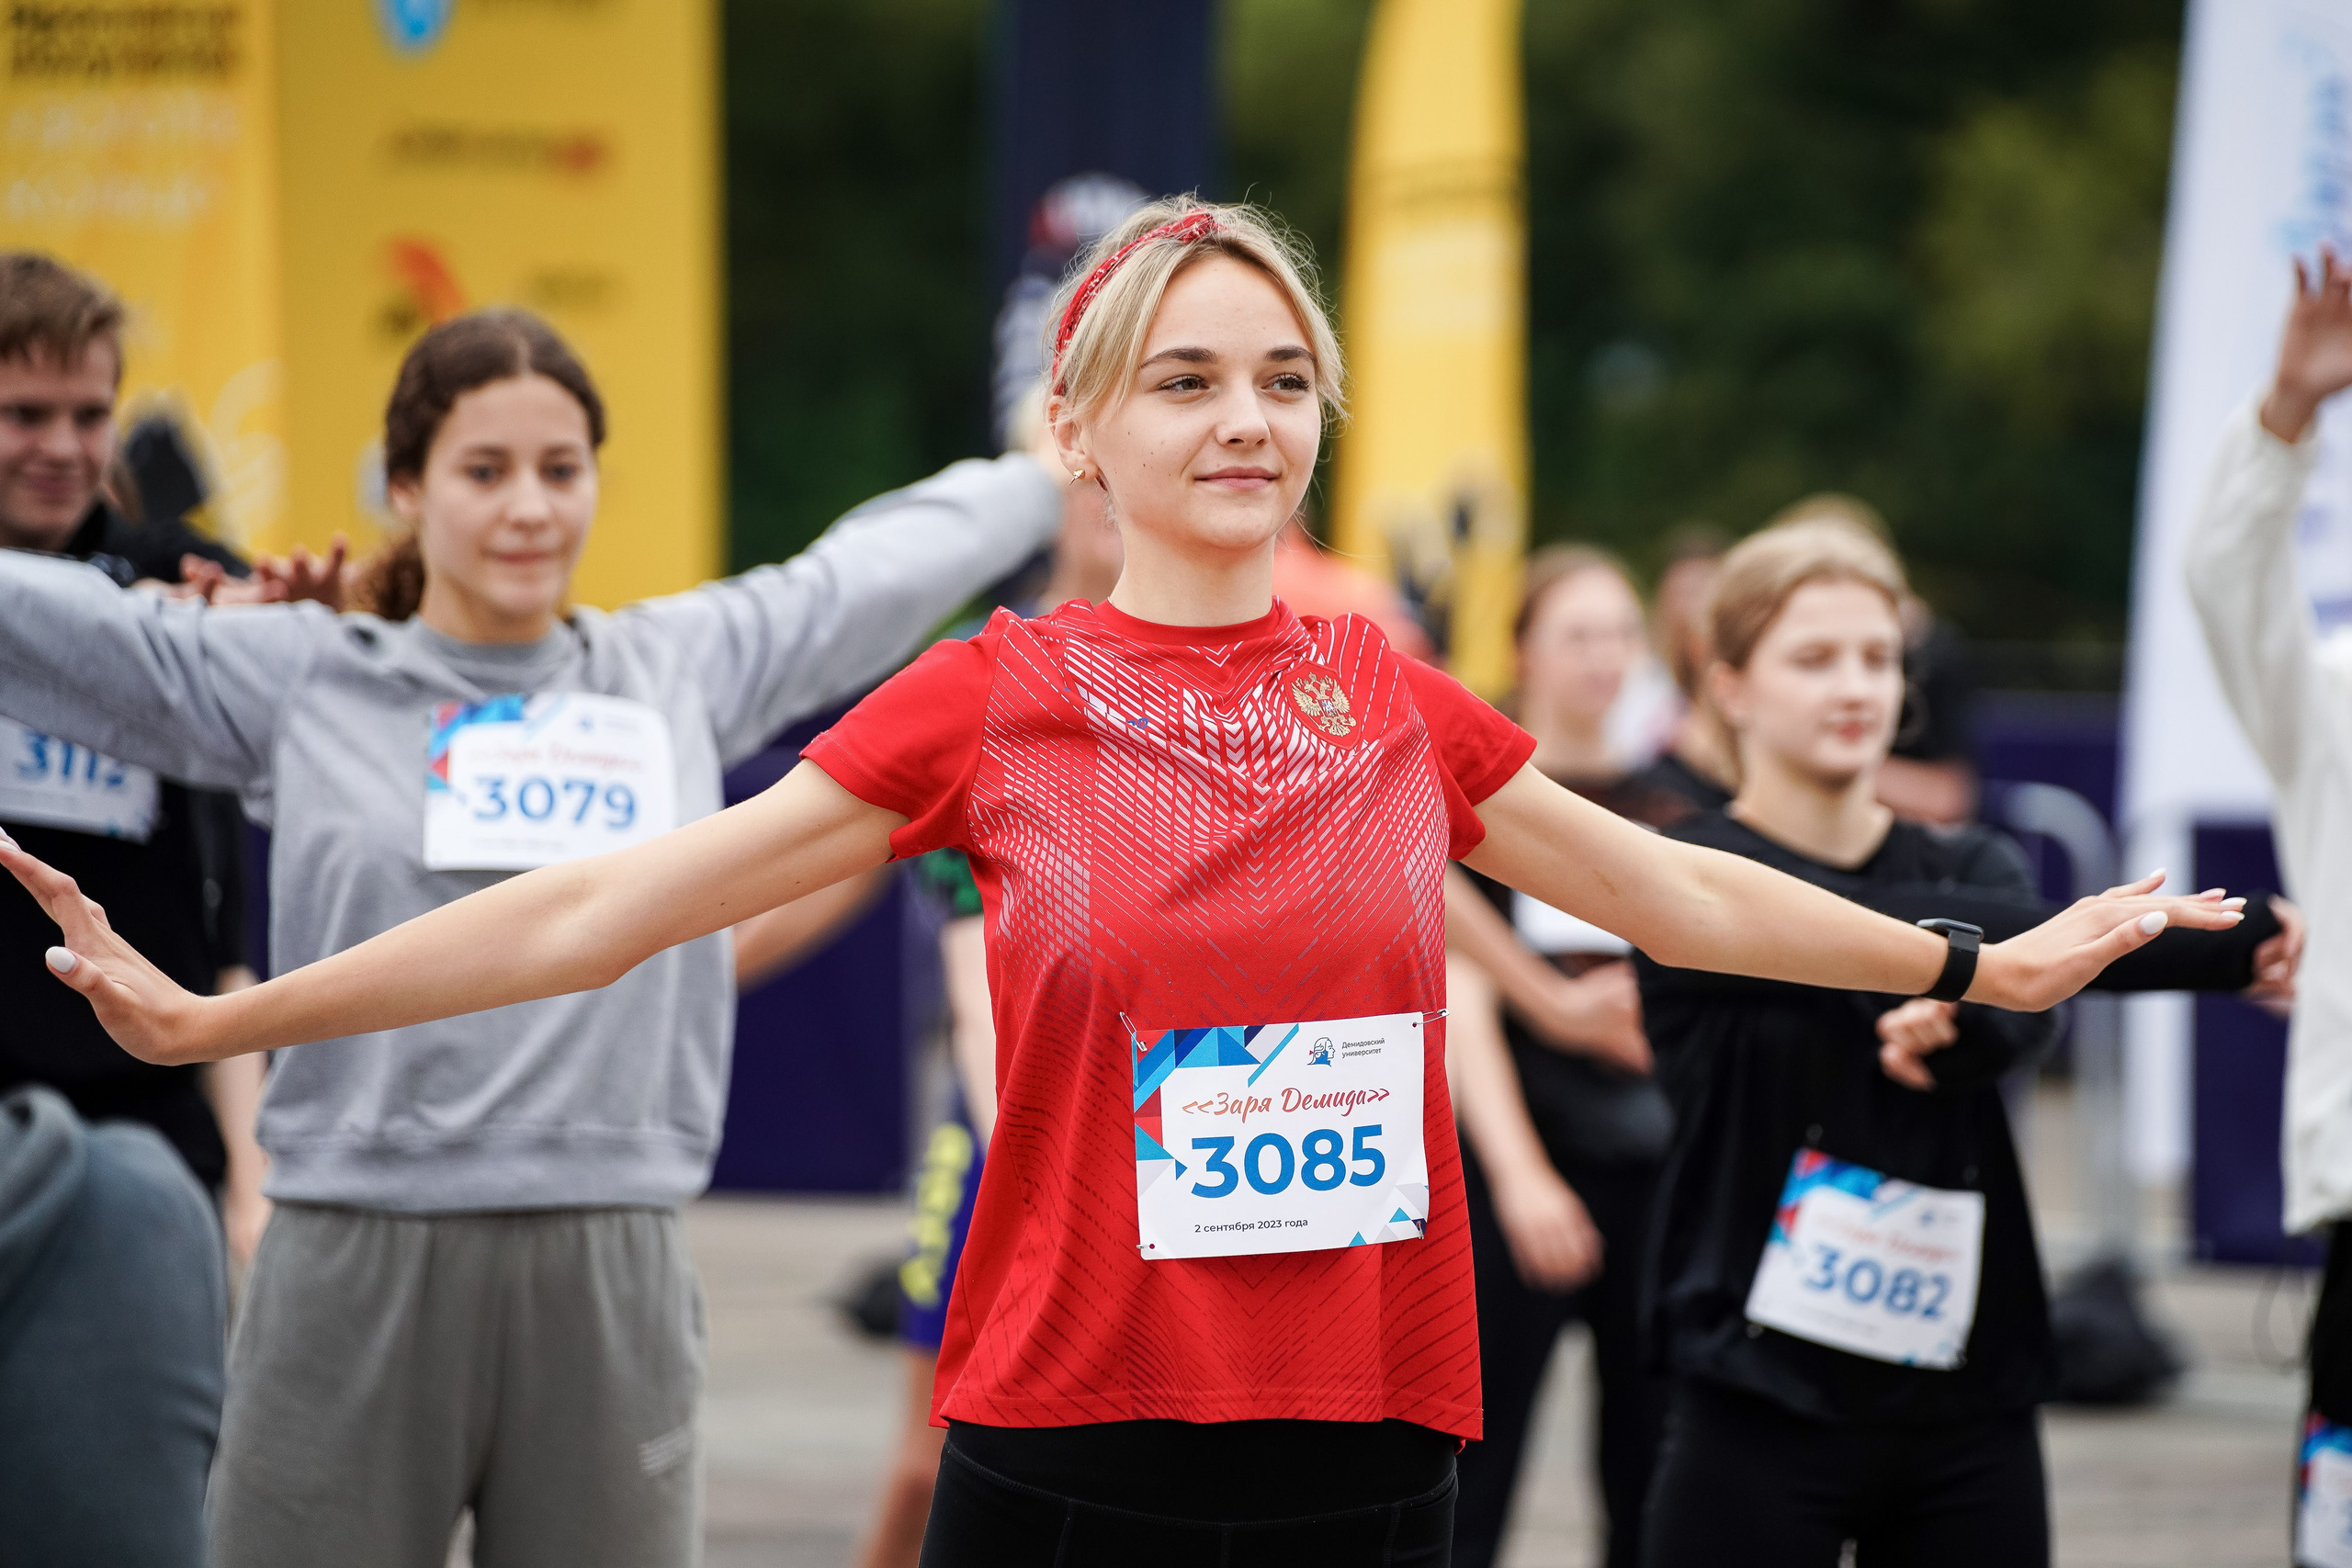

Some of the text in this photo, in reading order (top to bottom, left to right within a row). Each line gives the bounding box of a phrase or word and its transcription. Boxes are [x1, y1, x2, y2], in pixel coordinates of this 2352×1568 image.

[473, 774, 637, 831] 3079
[1341, 1037, 1385, 1049] Демидовский
[1341, 1048, 1382, 1059] университет
[1191, 1123, 1385, 1199] 3085
[1194, 1218, 1308, 1233] 2 сентября 2023 года
[1804, 1242, 1953, 1321] 3082
